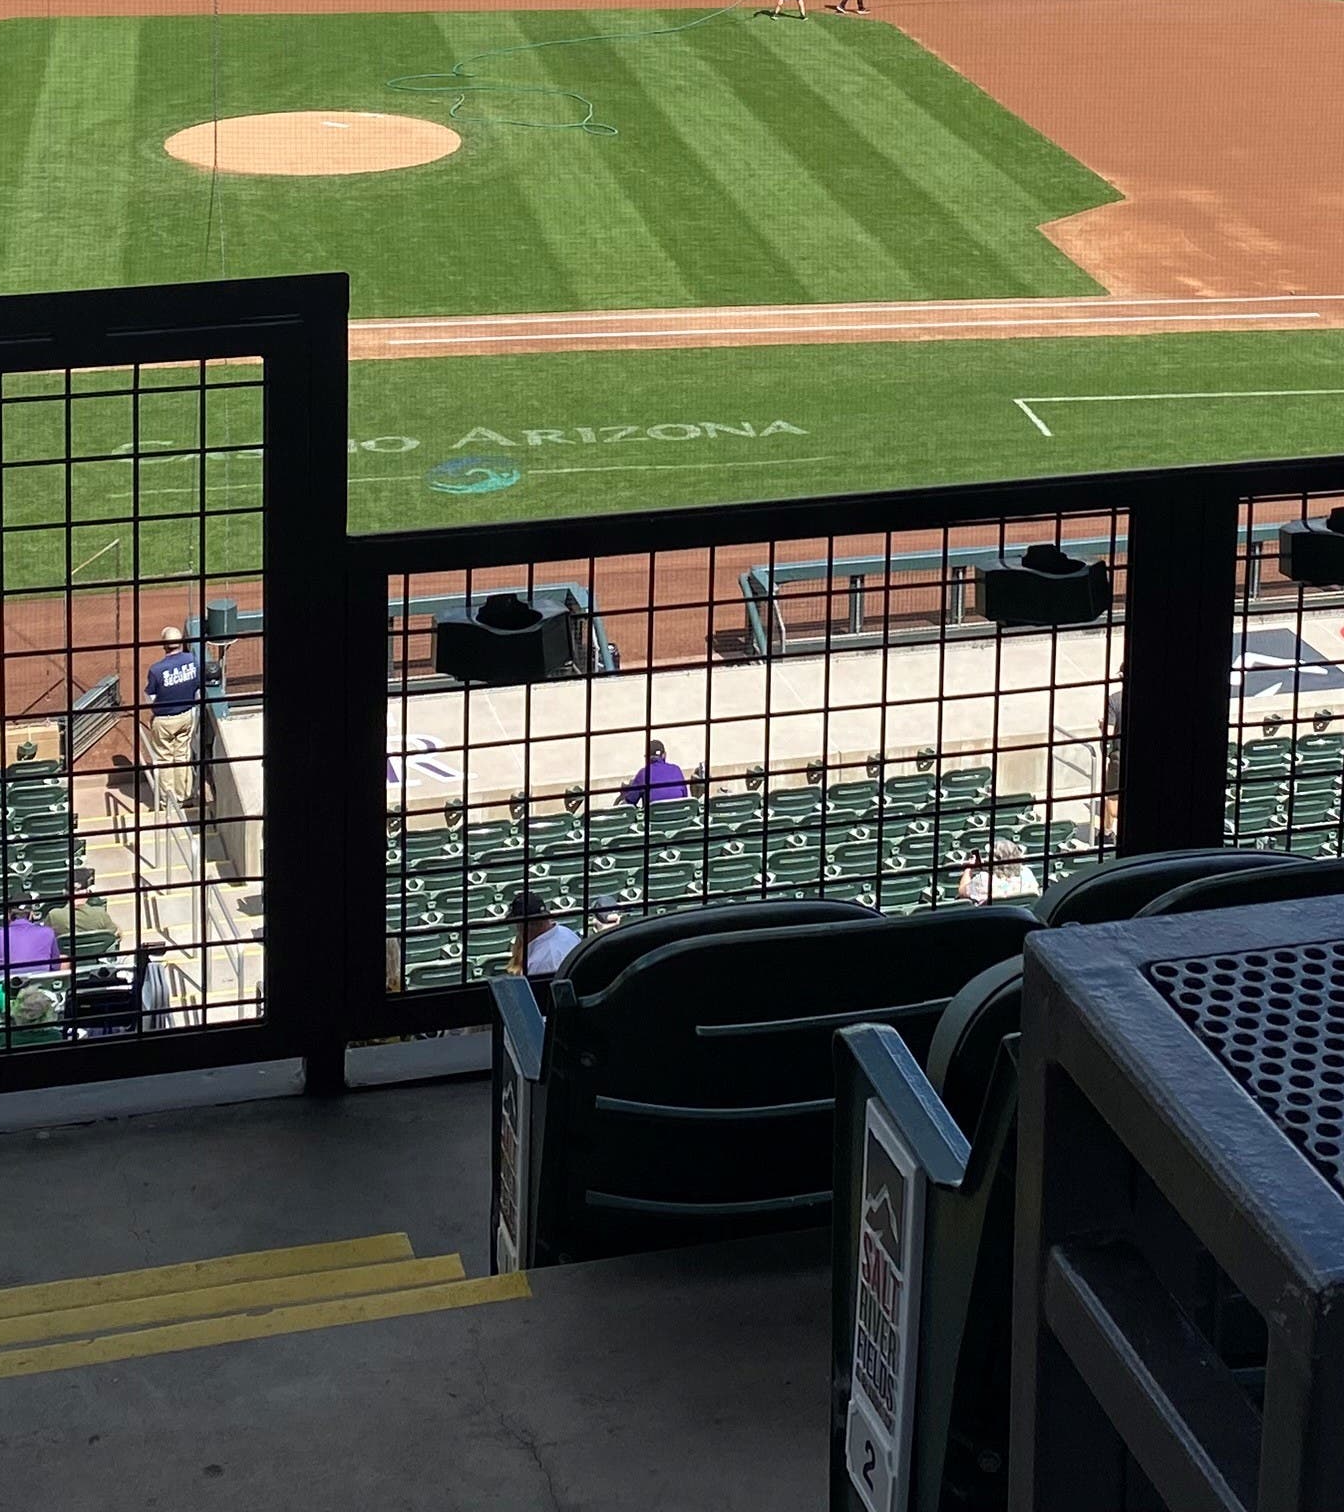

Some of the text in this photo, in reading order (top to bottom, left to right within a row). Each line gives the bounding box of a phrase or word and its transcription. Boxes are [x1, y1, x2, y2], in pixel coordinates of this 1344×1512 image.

[451, 418, 811, 449] ARIZONA
[163, 668, 197, 687] SECURITY
[861, 1230, 903, 1326] SALT
[859, 1279, 899, 1378] RIVER
[856, 1324, 895, 1413] FIELDS
[863, 1439, 876, 1492] 2
